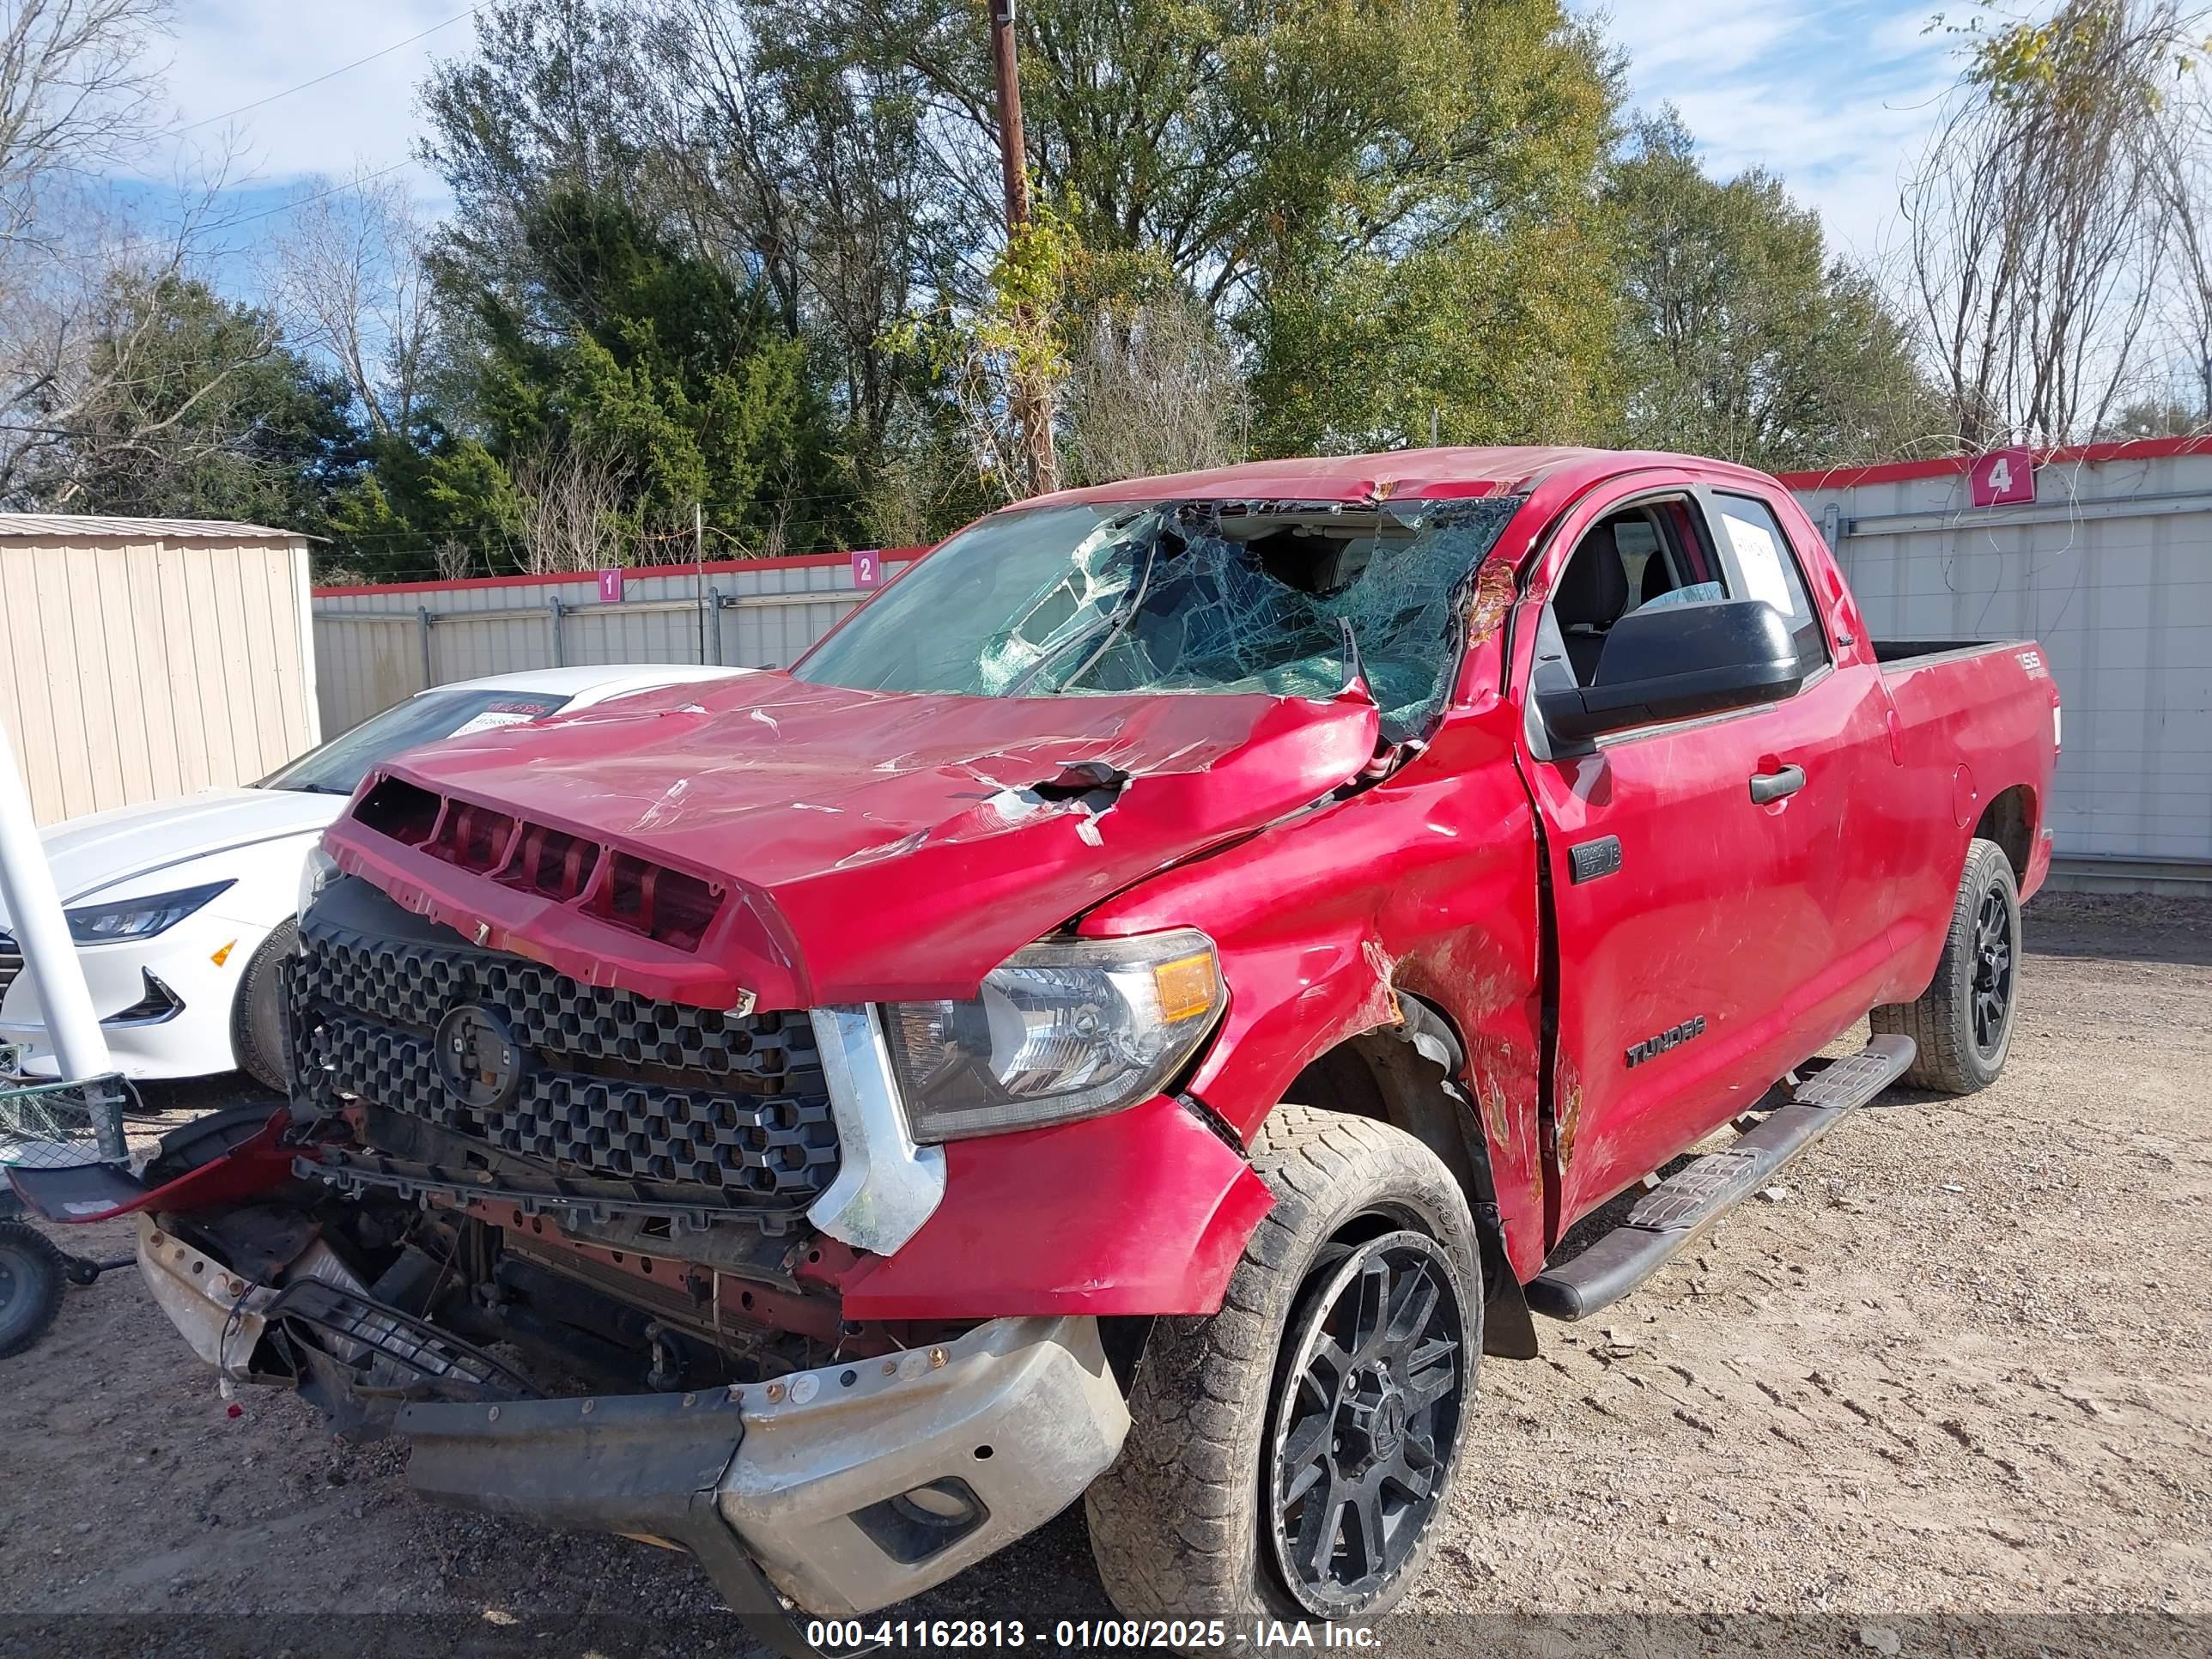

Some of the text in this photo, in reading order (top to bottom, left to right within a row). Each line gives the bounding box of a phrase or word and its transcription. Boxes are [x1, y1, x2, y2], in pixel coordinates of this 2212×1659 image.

[1989, 458, 2013, 493] 4
[860, 557, 872, 581] 2
[605, 574, 612, 595] 1
[1626, 1014, 1707, 1069] TUNDRA
